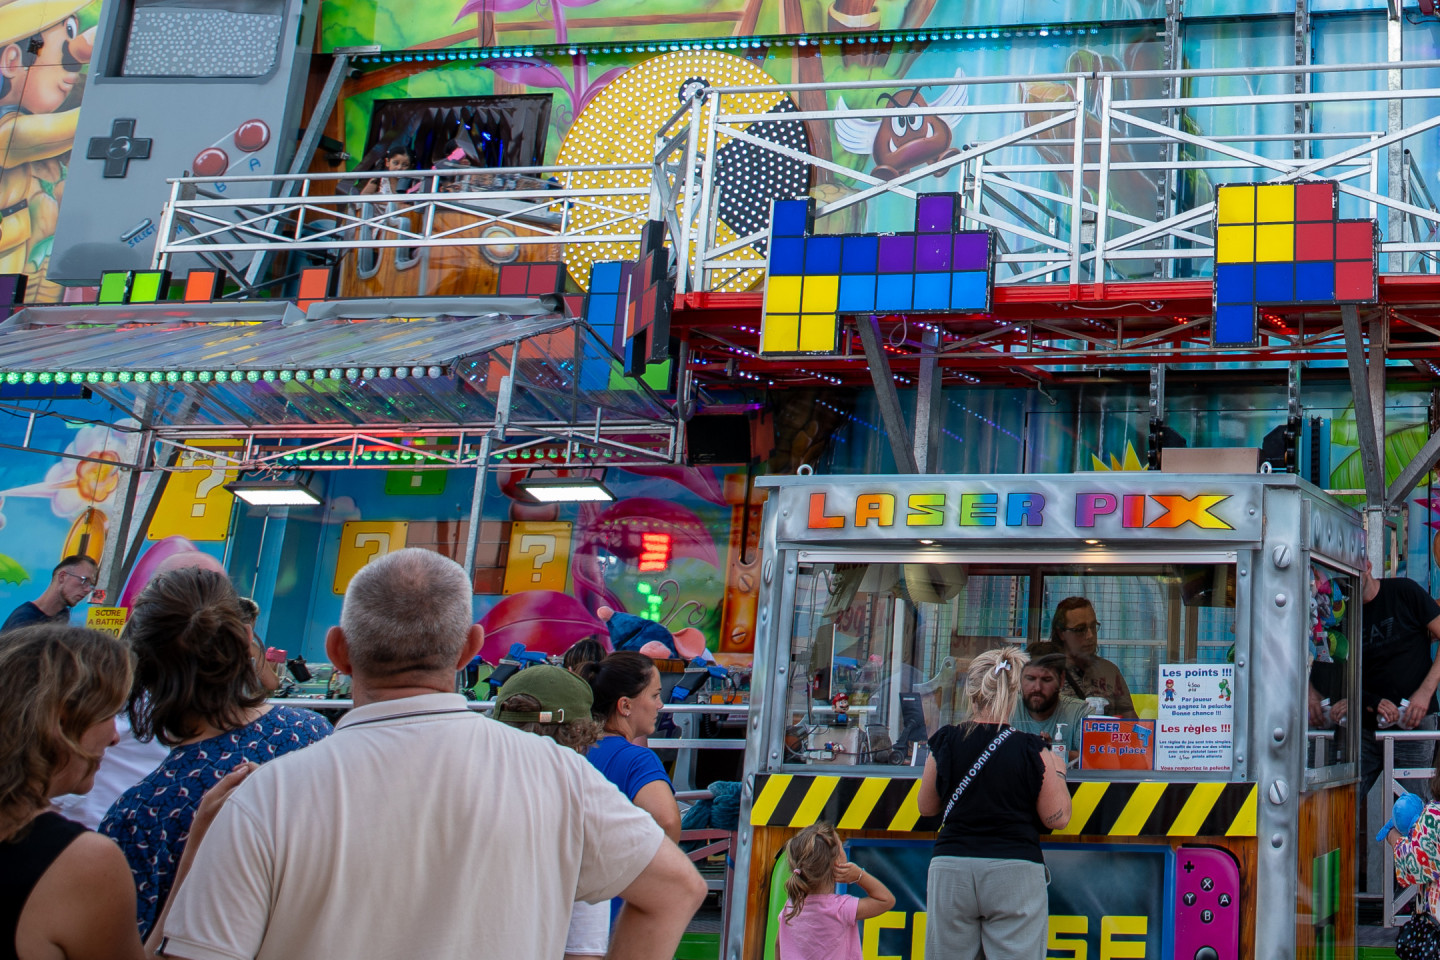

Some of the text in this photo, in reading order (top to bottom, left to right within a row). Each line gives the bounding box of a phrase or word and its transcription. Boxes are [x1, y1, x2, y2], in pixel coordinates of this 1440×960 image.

[128, 224, 157, 248] SELECT
[807, 492, 1237, 531] LASER PIX
[95, 609, 121, 617] SCORE
[1162, 668, 1232, 679] Les points !!!
[1085, 722, 1120, 732] LASER
[1161, 724, 1231, 735] Les règles !!!
[988, 729, 1012, 752] HUGO
[1111, 733, 1131, 742] PIX
[1089, 745, 1146, 756] 5 € la place
[968, 750, 991, 777] HUGO
[952, 775, 972, 801] HUGO
